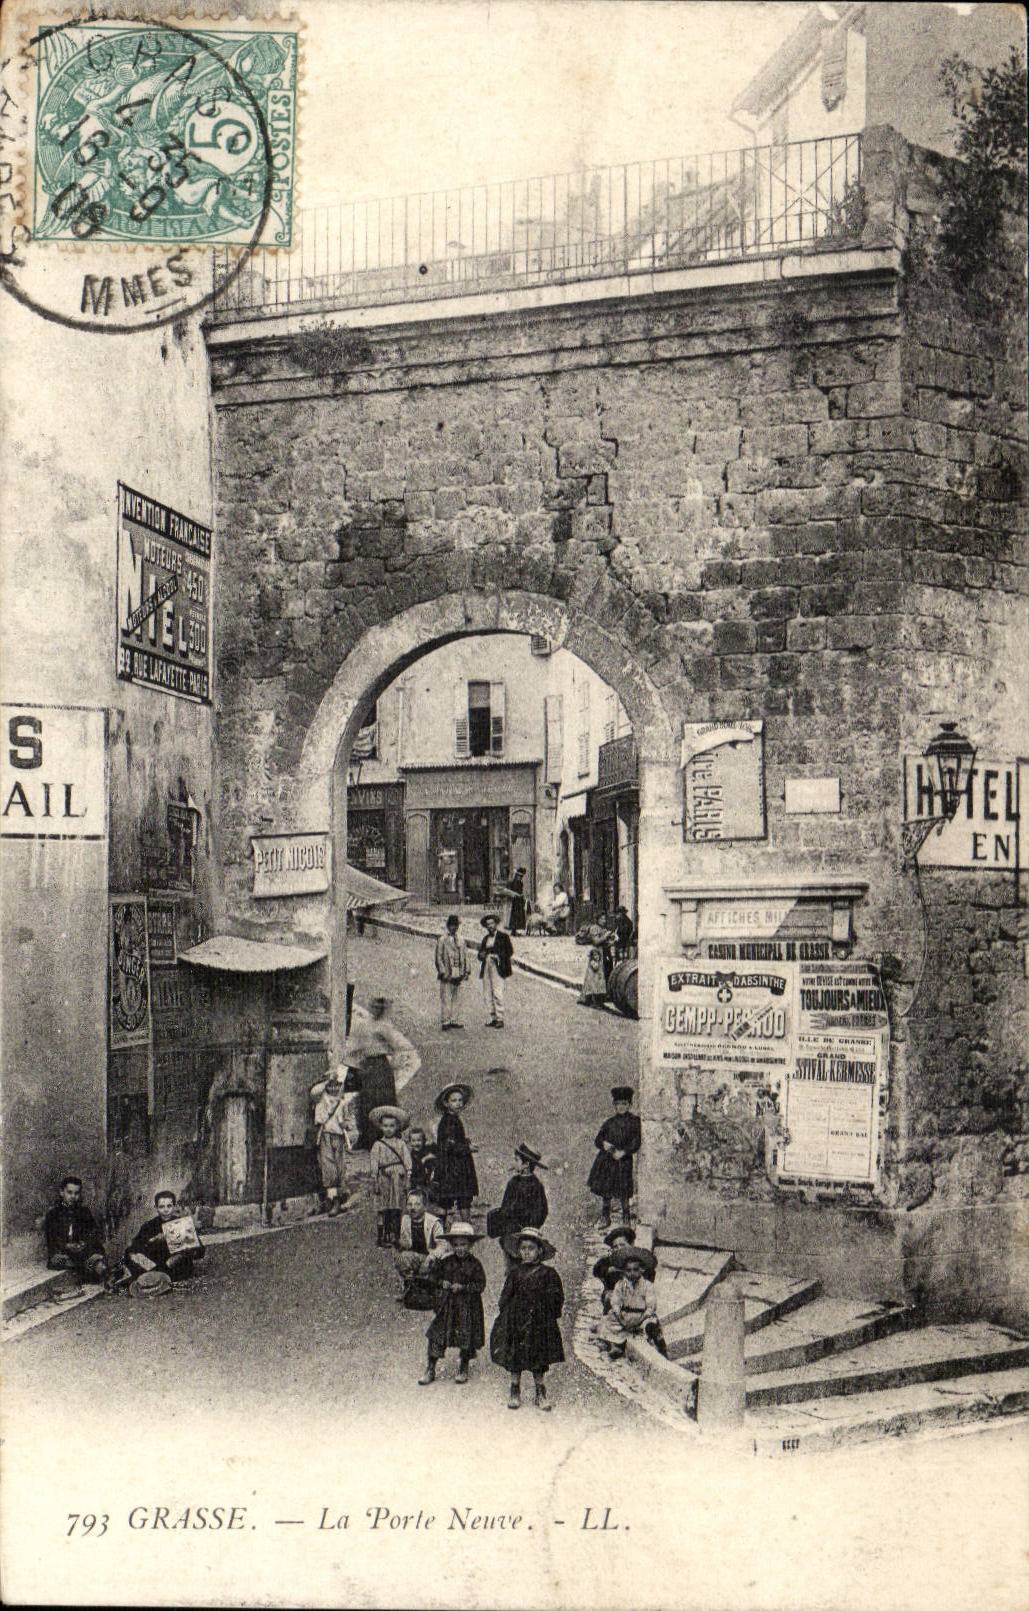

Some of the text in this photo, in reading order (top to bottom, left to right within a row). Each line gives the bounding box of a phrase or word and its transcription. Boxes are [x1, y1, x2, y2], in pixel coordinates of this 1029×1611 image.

[271, 93, 292, 185] POSTES
[2, 780, 88, 818] AIL
[916, 764, 1021, 822] HTEL
[971, 832, 1011, 861] EN
[708, 910, 760, 924] AFFICHES
[671, 974, 718, 986] EXTRAIT
[800, 988, 850, 1011] TOUJOURS
[816, 1052, 846, 1060] GRAND
[830, 1059, 876, 1085] KERMESSE
